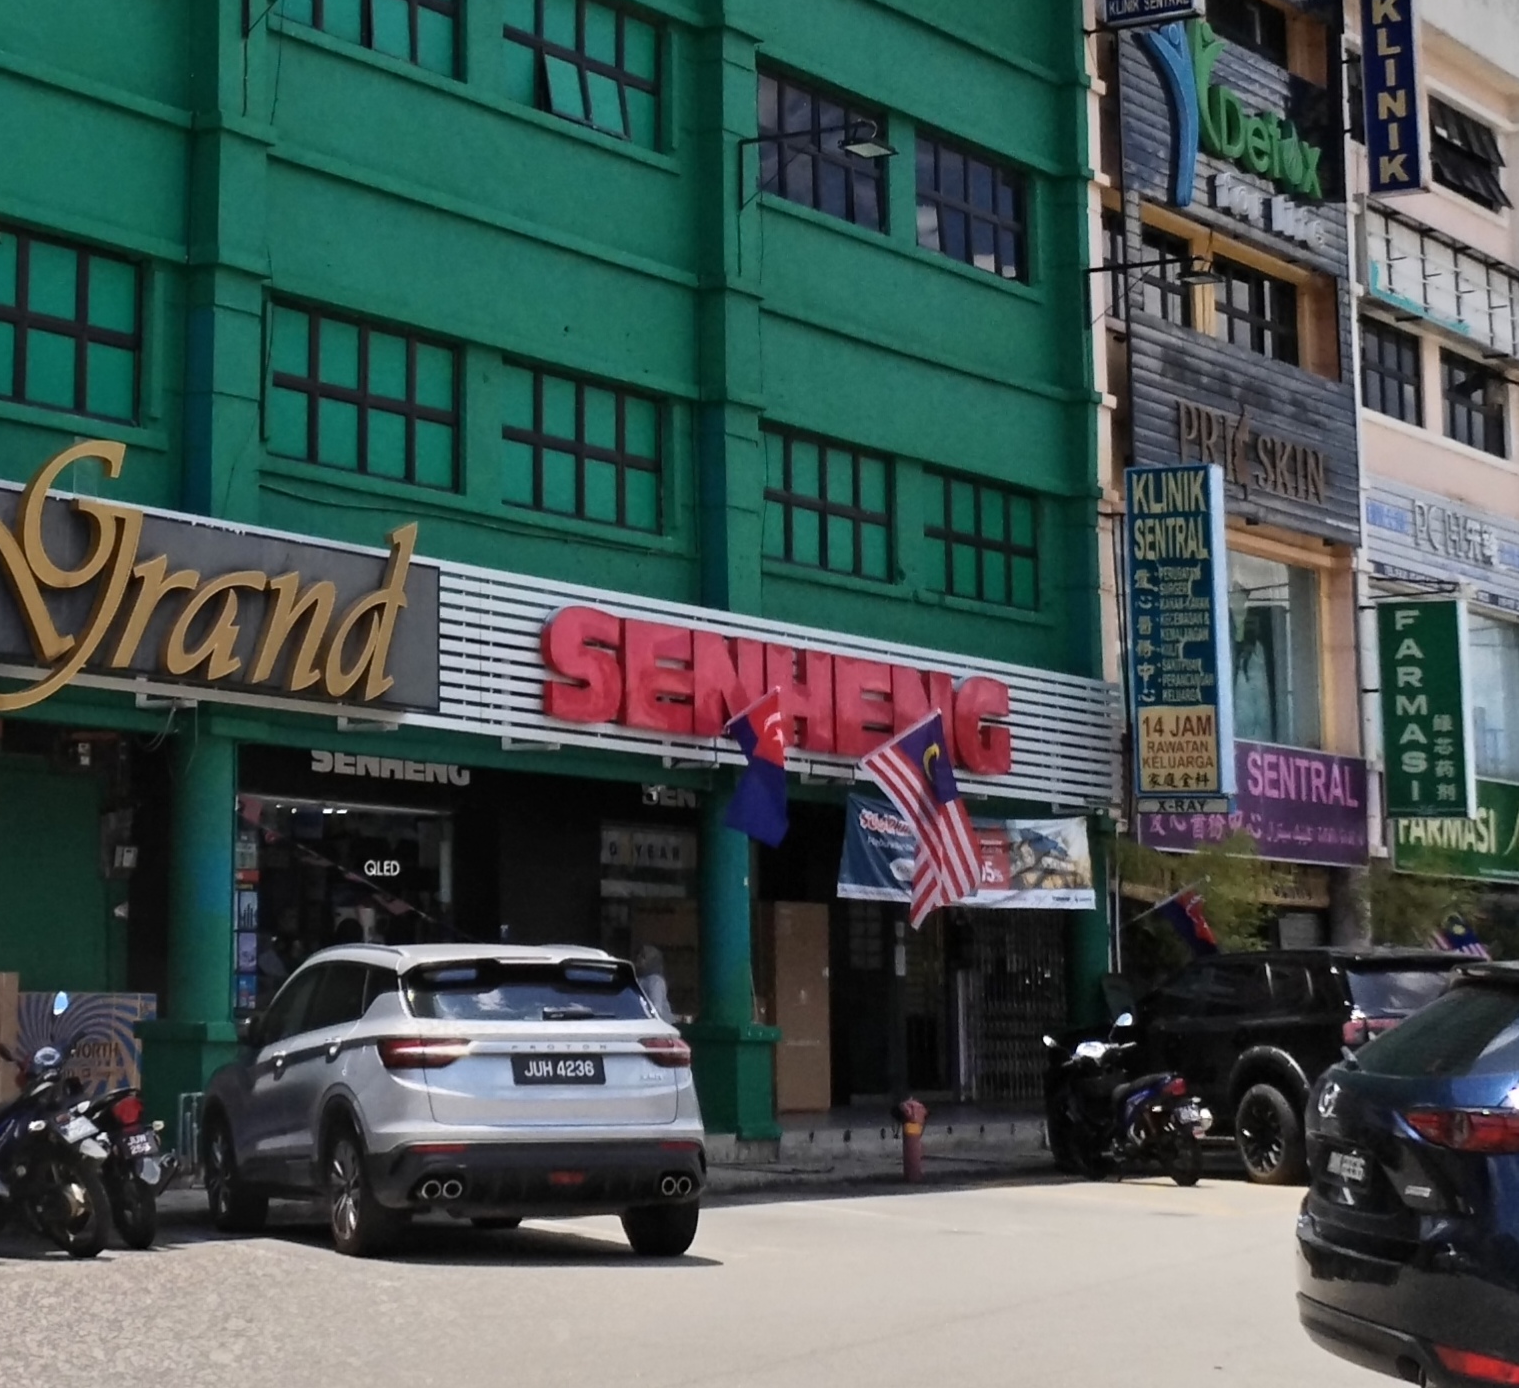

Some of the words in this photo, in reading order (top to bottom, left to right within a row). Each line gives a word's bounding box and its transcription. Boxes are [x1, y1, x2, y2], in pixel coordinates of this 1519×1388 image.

[1251, 435, 1325, 506] SKIN
[1132, 469, 1207, 515] KLINIK
[1133, 516, 1211, 561] SENTRAL
[539, 604, 1012, 775] SENHENG
[1394, 609, 1430, 802] FARMASI
[1142, 715, 1165, 738] 14
[1169, 714, 1212, 738] JAM
[1141, 755, 1214, 770] KELUARGA
[1147, 740, 1209, 755] RAWATAN
[1246, 750, 1360, 808] SENTRAL
[1157, 799, 1208, 812] X-RAY
[1397, 807, 1497, 855] FARMASI
[363, 859, 401, 877] QLED
[511, 1043, 607, 1051] PROTON
[524, 1059, 554, 1077] JUH
